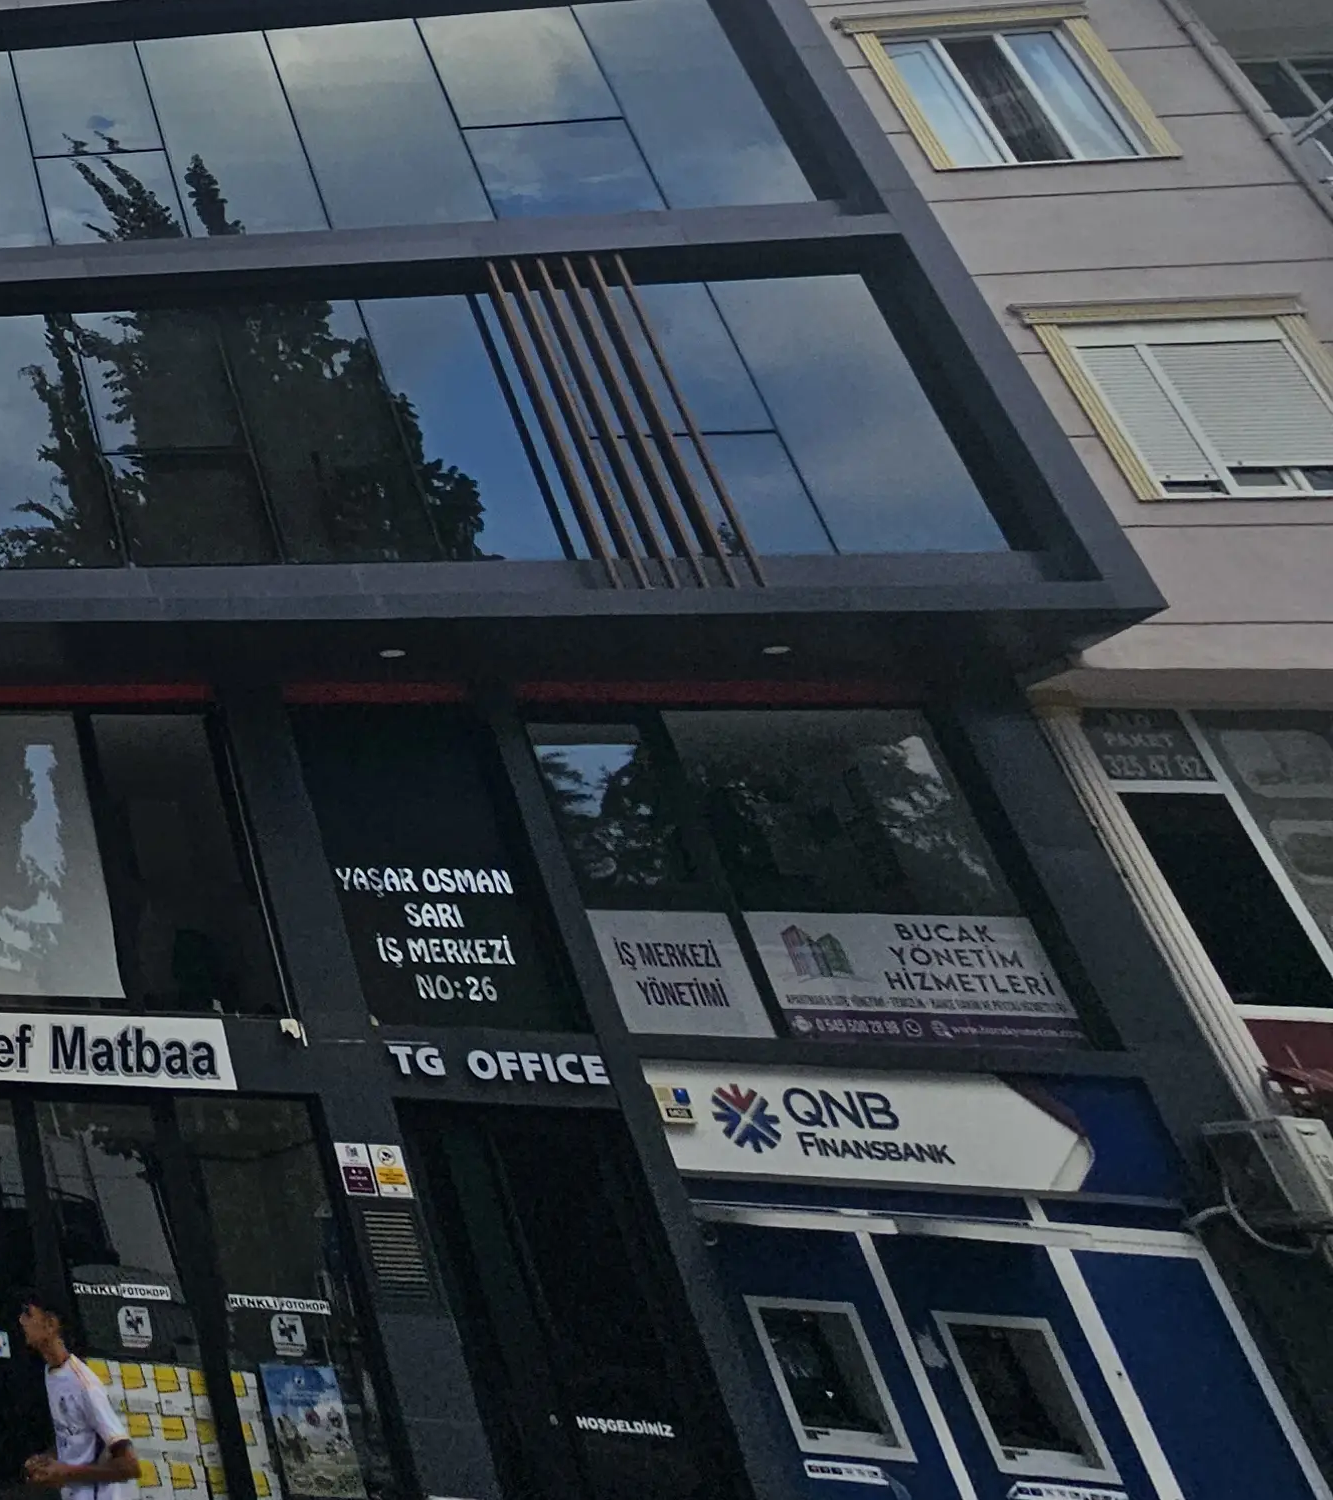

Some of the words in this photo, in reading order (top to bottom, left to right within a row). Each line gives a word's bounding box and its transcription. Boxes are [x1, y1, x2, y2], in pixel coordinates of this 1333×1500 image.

[335, 866, 419, 898] YAŞAR
[422, 867, 514, 895] OSMAN
[404, 902, 464, 930] SARI
[894, 922, 997, 944] BUCAK
[376, 935, 404, 967] İŞ
[407, 936, 517, 967] MERKEZİ
[616, 938, 637, 971] İŞ
[639, 937, 721, 969] MERKEZİ
[888, 944, 1025, 969] YÖNETİM
[637, 976, 730, 1009] YÖNETİMİ
[883, 968, 1057, 996] HİZMETLERİ
[50, 1024, 221, 1080] Matbaa
[388, 1043, 446, 1076] TG
[468, 1049, 611, 1086] OFFICE
[782, 1086, 900, 1132] QNB
[797, 1130, 956, 1166] FINANSBANK
[574, 1414, 674, 1440] HOŞGELDİNİZ
